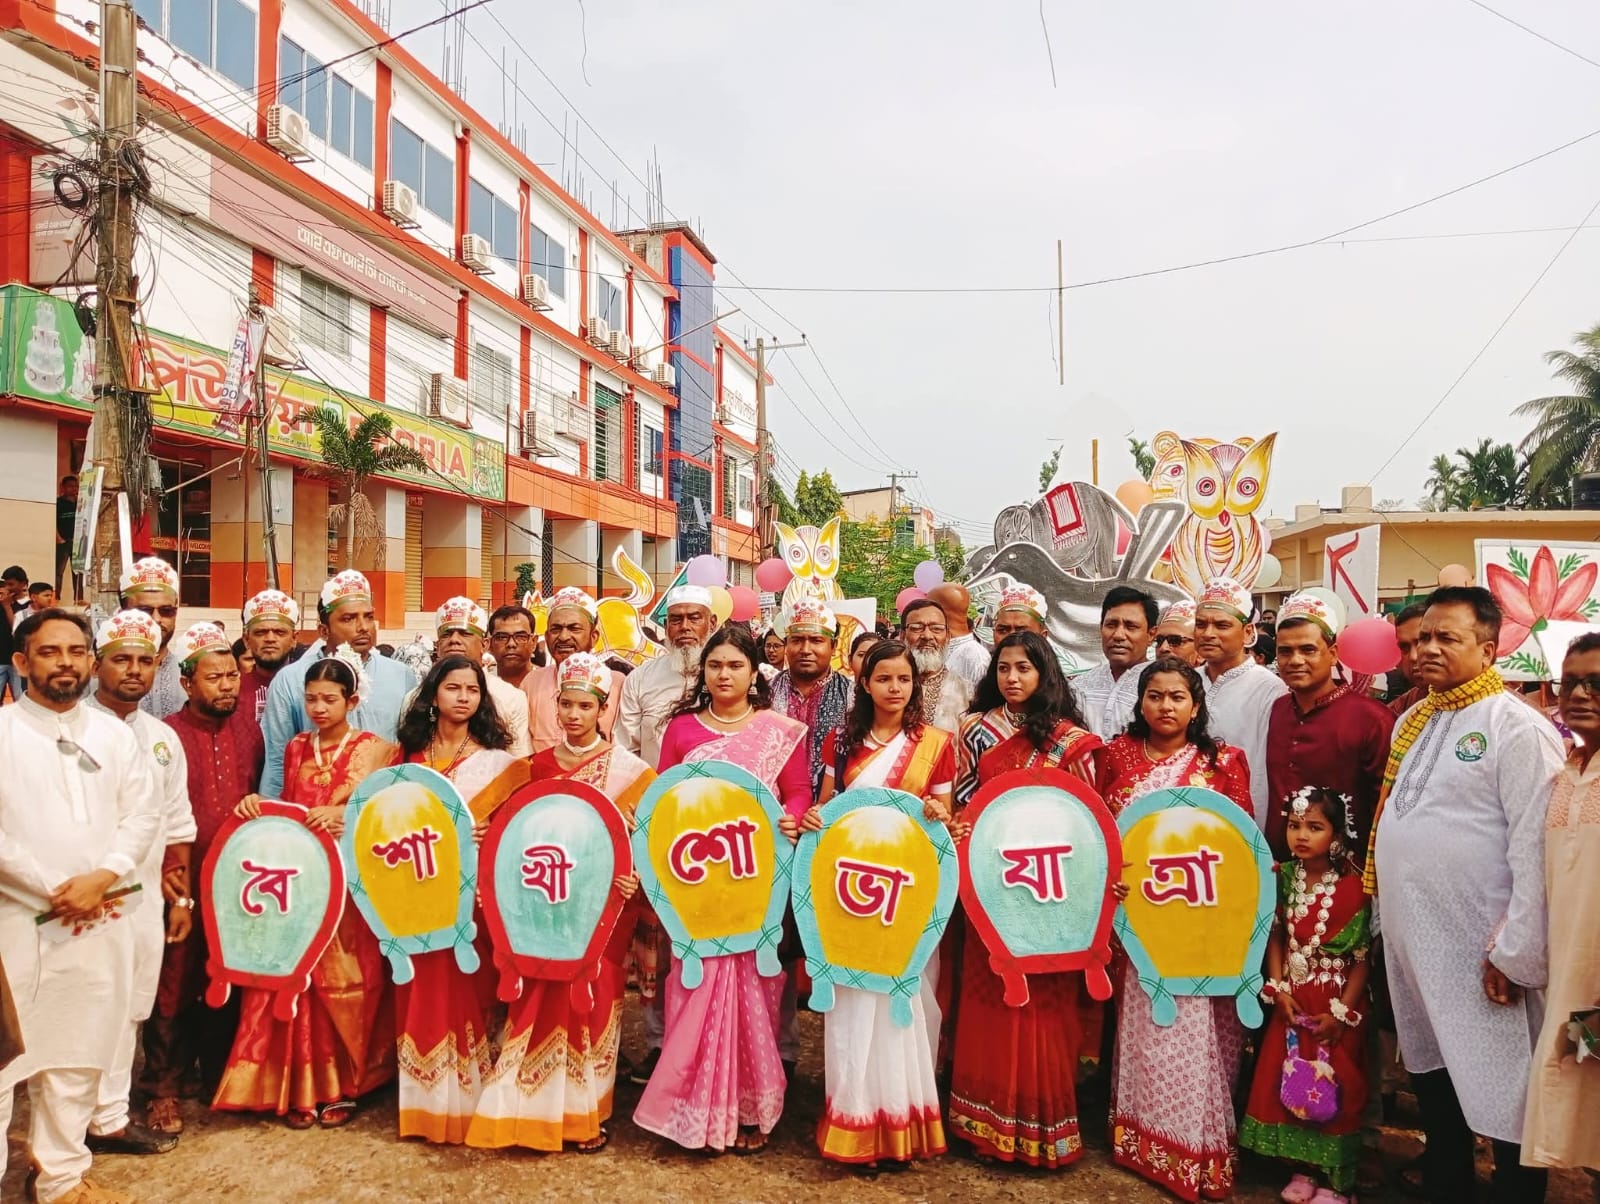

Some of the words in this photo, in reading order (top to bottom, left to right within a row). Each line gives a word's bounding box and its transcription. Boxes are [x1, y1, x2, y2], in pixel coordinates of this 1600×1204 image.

[372, 826, 442, 882] শা
[520, 845, 574, 905] খী
[669, 816, 760, 885] শো
[1002, 845, 1073, 902] যা
[1141, 847, 1224, 907] ত্রা
[239, 859, 301, 917] বৈ
[834, 856, 914, 926] ভা
